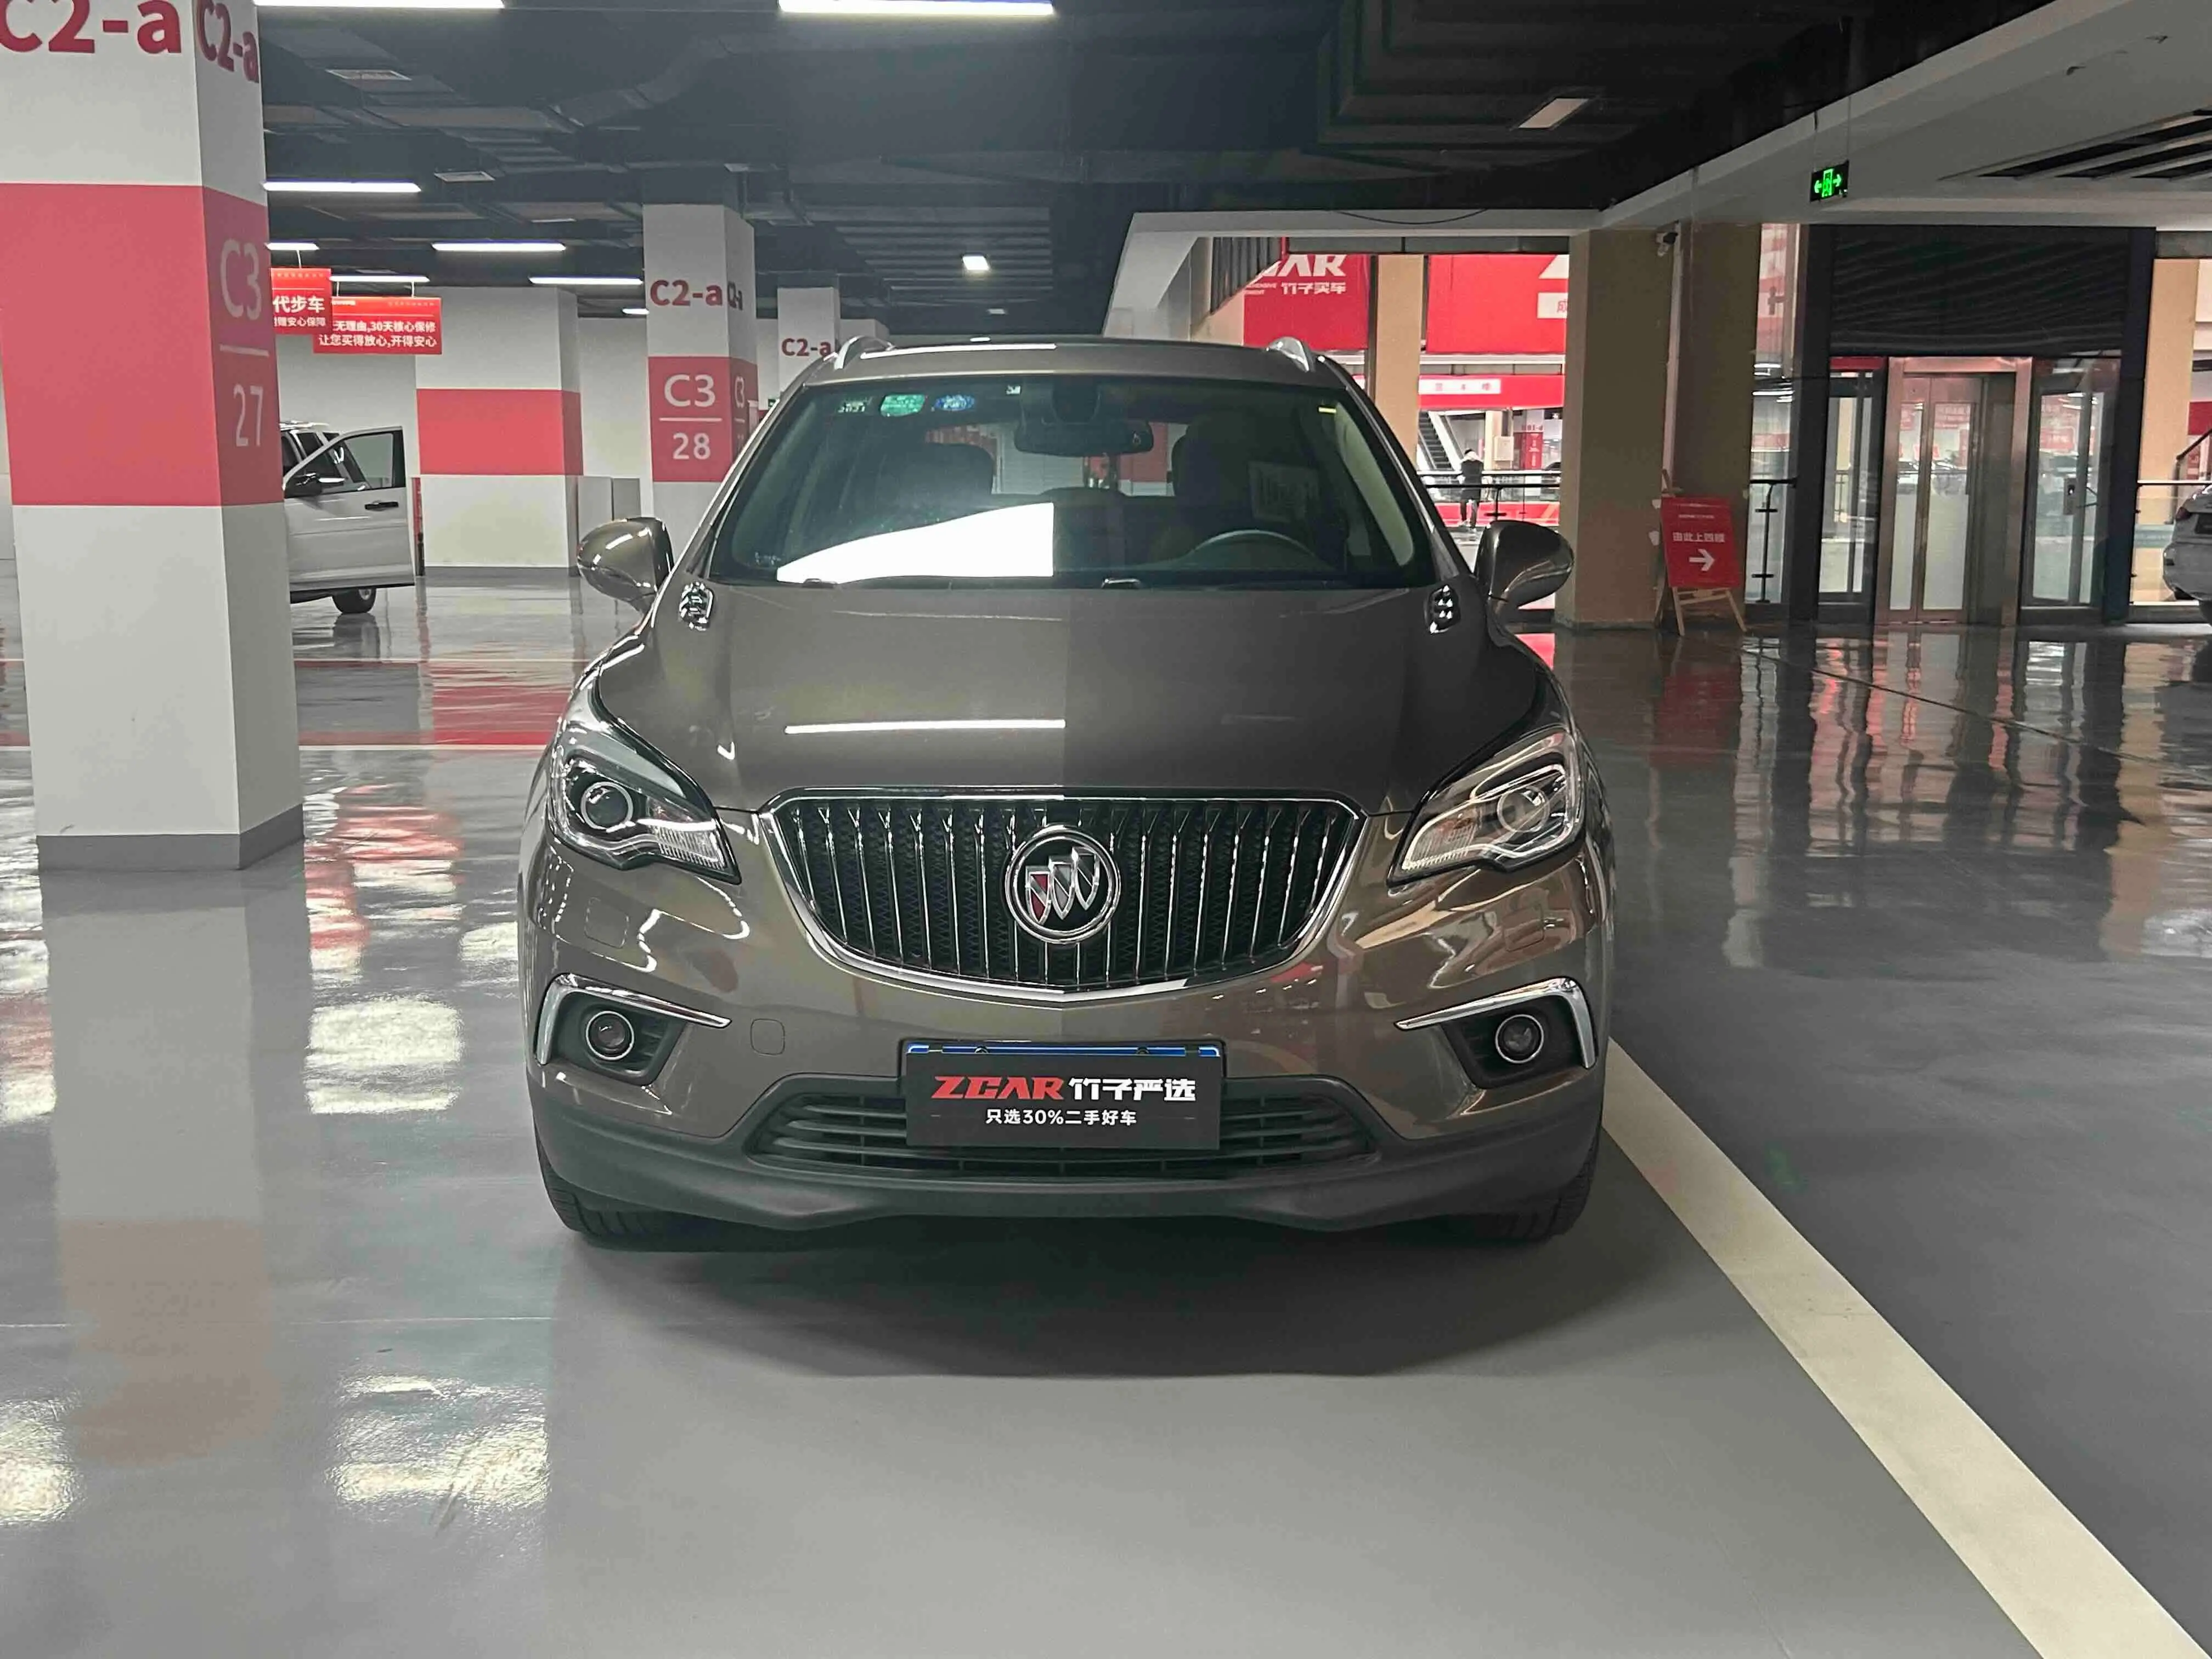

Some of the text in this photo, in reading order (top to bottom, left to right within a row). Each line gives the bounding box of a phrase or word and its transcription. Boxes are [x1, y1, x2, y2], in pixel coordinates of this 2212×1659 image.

[0, 0, 182, 54] C2-a
[196, 0, 259, 83] C2-a
[221, 239, 262, 320] C3
[1282, 282, 1346, 294] 竹子买车
[273, 295, 325, 313] 代步车
[650, 280, 723, 306] C2-a
[319, 334, 437, 348] 让您买得放心,开得安心
[781, 338, 831, 357] C2-a
[664, 374, 716, 407] C3
[233, 383, 263, 447] 27
[673, 432, 712, 460] 28
[932, 1076, 1196, 1101] ZGAR 竹子严选
[986, 1109, 1137, 1126] 只选30%二手好车
